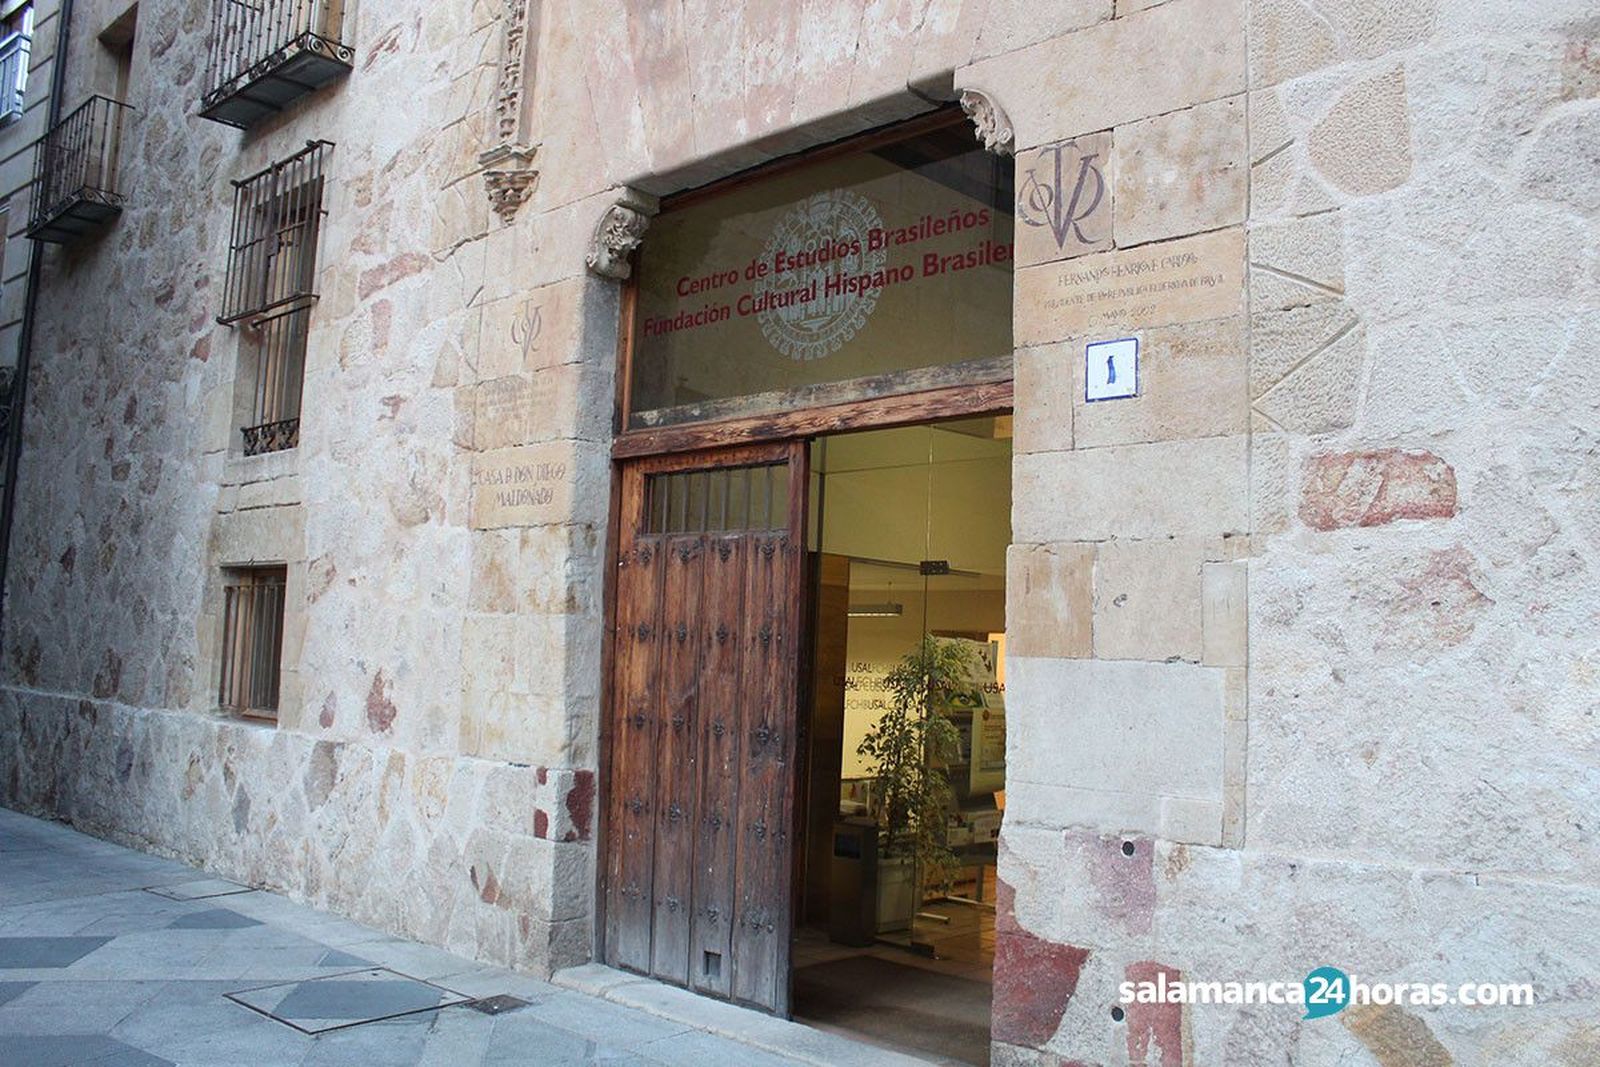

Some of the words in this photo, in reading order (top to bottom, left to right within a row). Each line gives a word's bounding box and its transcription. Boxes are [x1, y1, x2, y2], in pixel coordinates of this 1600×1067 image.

[676, 269, 738, 297] Centro
[745, 259, 768, 281] de
[775, 238, 860, 274] Estudios
[868, 207, 989, 251] Brasileños
[643, 302, 730, 337] Fundación
[737, 279, 816, 317] Cultural
[825, 264, 914, 298] Hispano
